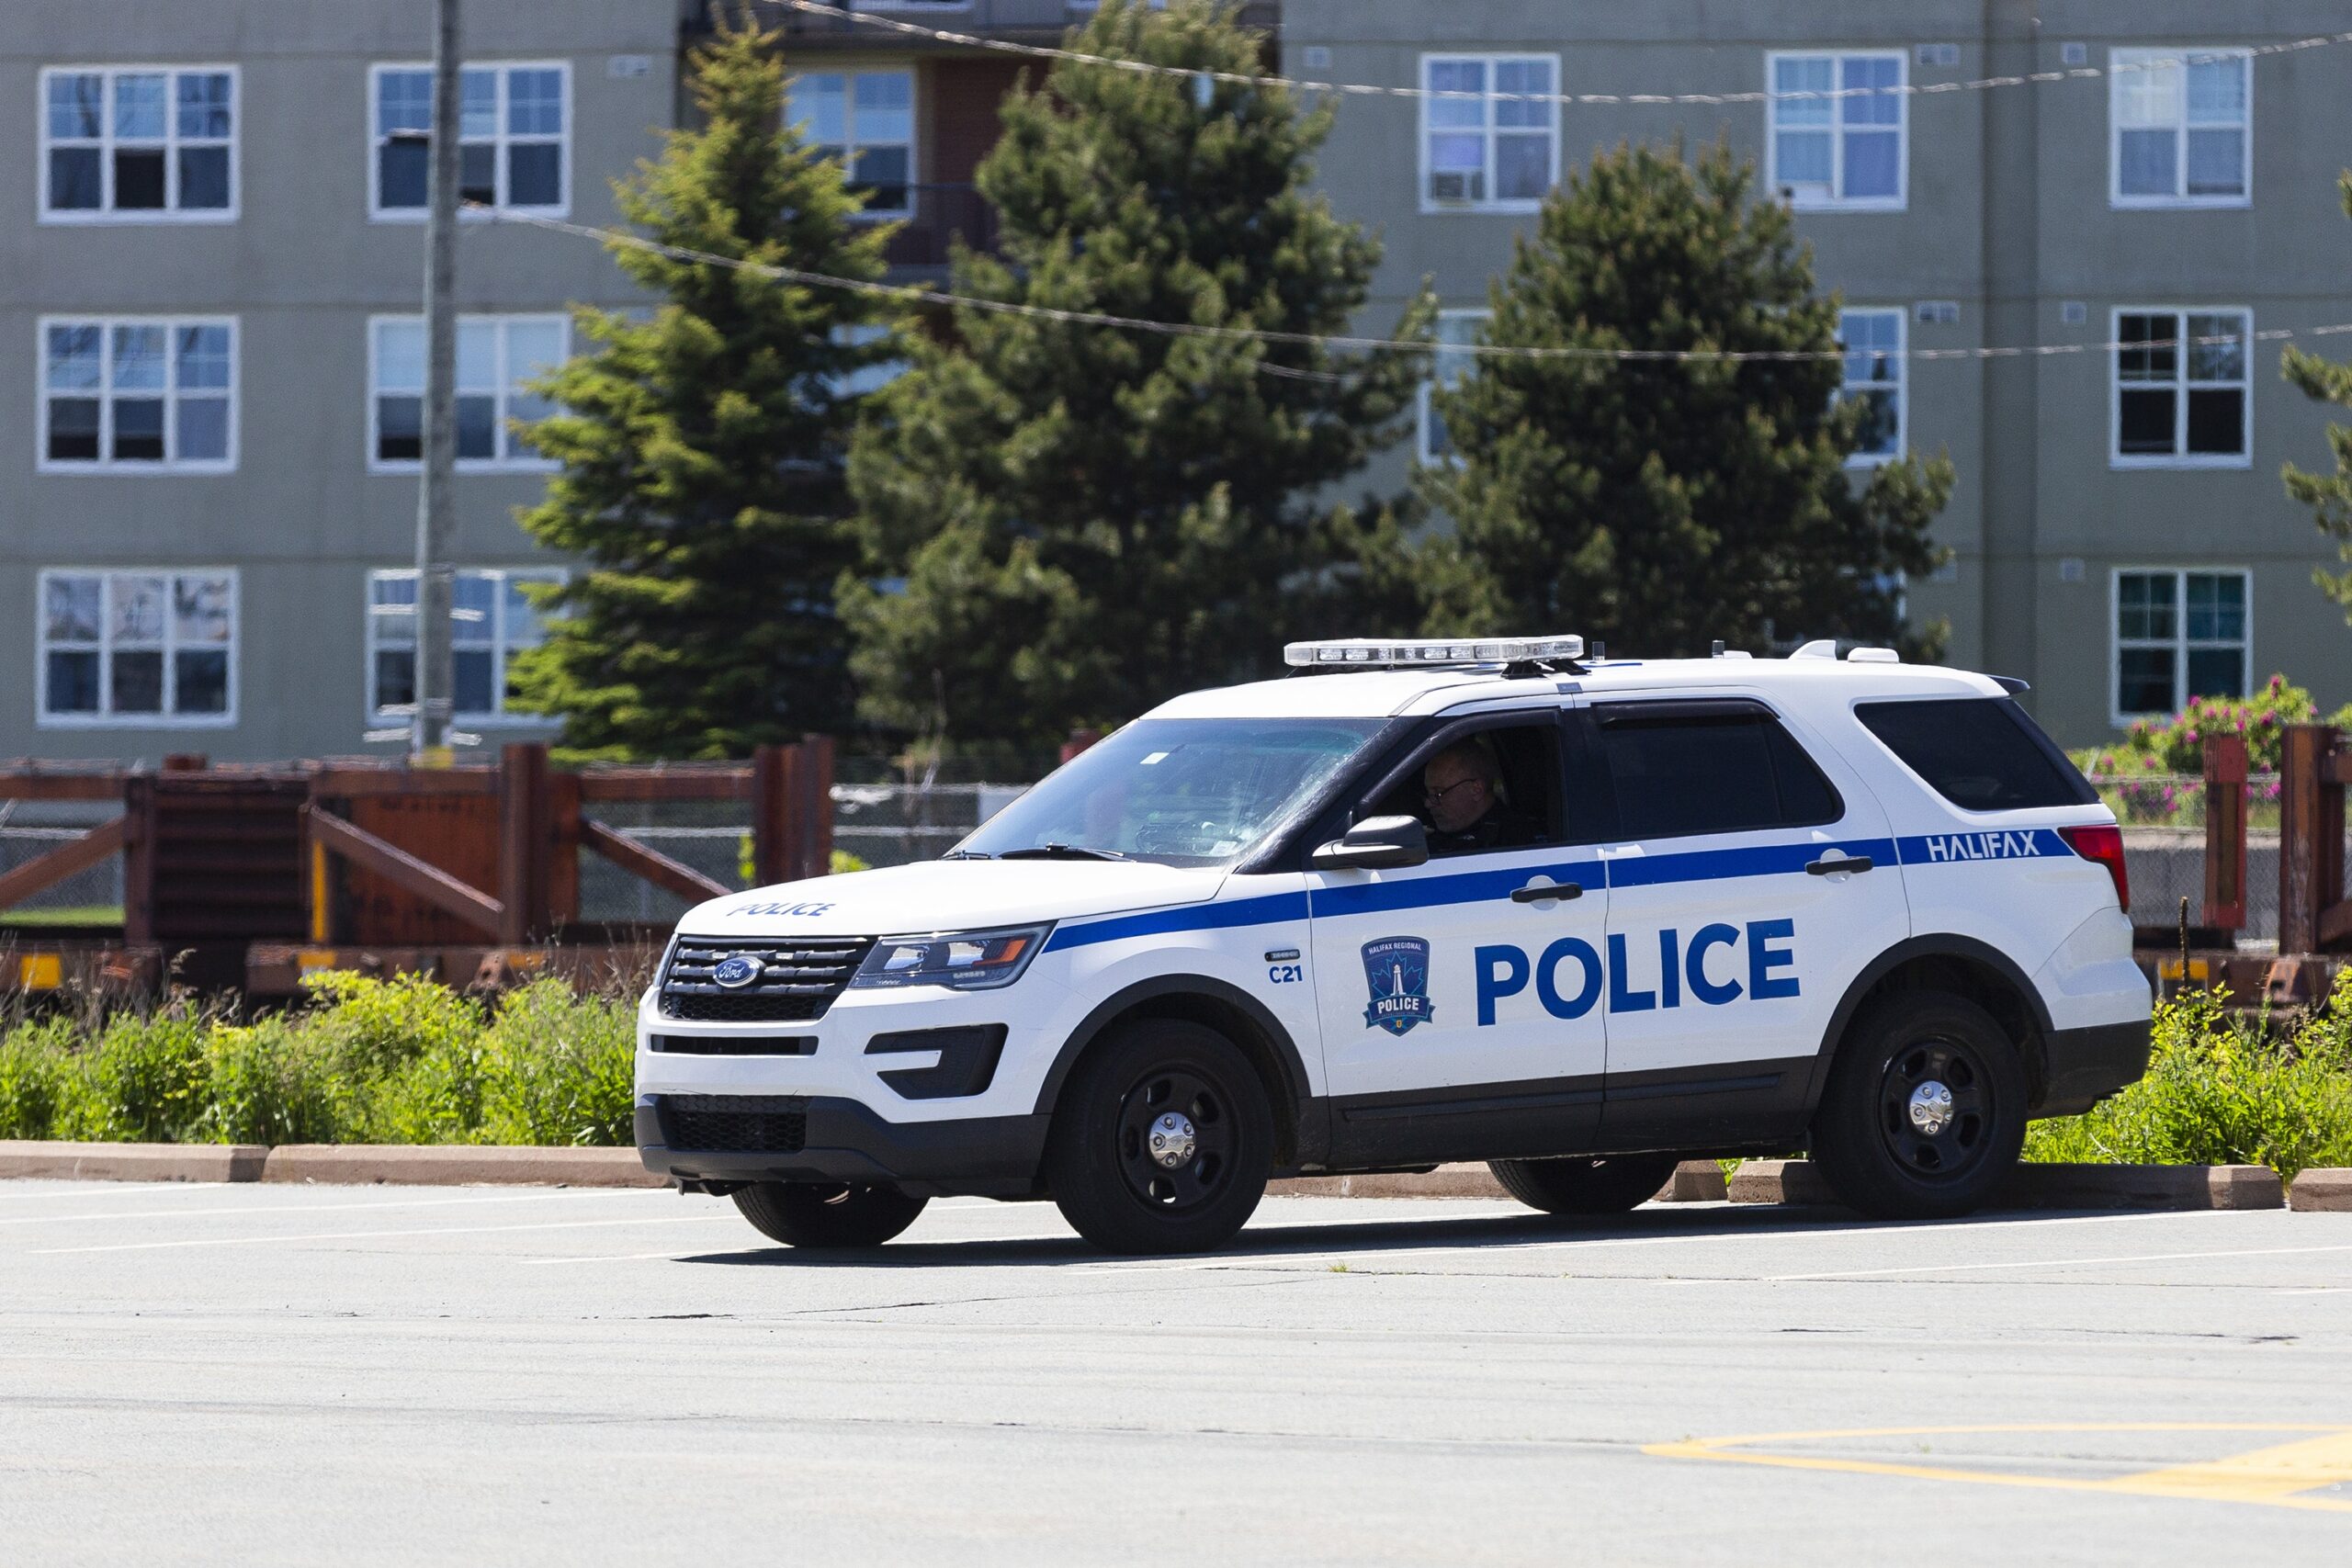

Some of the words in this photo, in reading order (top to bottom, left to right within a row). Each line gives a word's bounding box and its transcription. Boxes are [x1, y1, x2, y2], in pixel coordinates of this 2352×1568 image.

[1926, 830, 2041, 862] HALIFAX
[726, 902, 836, 917] POLICE
[1368, 942, 1393, 954] HALIFAX
[1393, 942, 1422, 951] REGIONAL
[718, 962, 746, 978] Ford
[1269, 964, 1303, 984] C21
[1475, 919, 1801, 1027] POLICE
[1377, 997, 1419, 1014] POLICE
